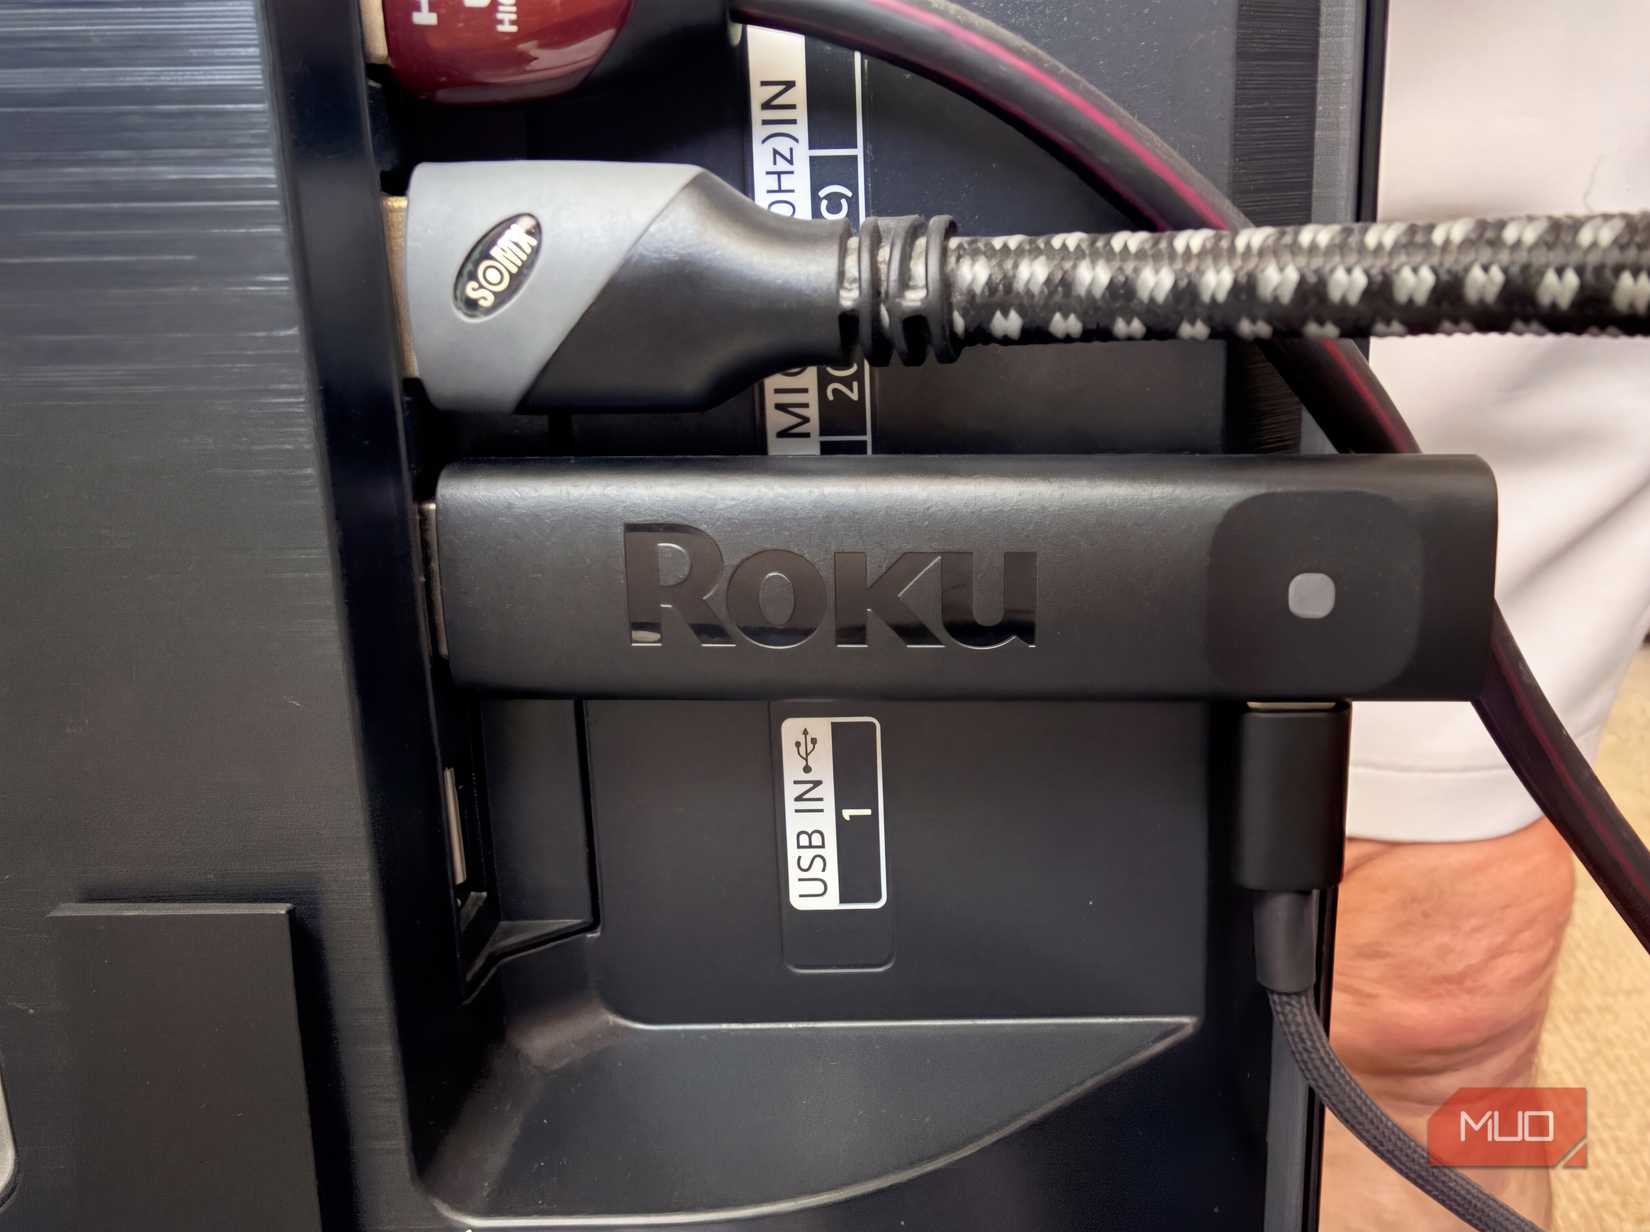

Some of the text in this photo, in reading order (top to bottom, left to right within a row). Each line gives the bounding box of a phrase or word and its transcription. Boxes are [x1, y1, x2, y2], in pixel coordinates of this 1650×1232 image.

[623, 522, 1037, 650] Roku
[793, 779, 828, 898] USB IN
[842, 808, 872, 821] 1
